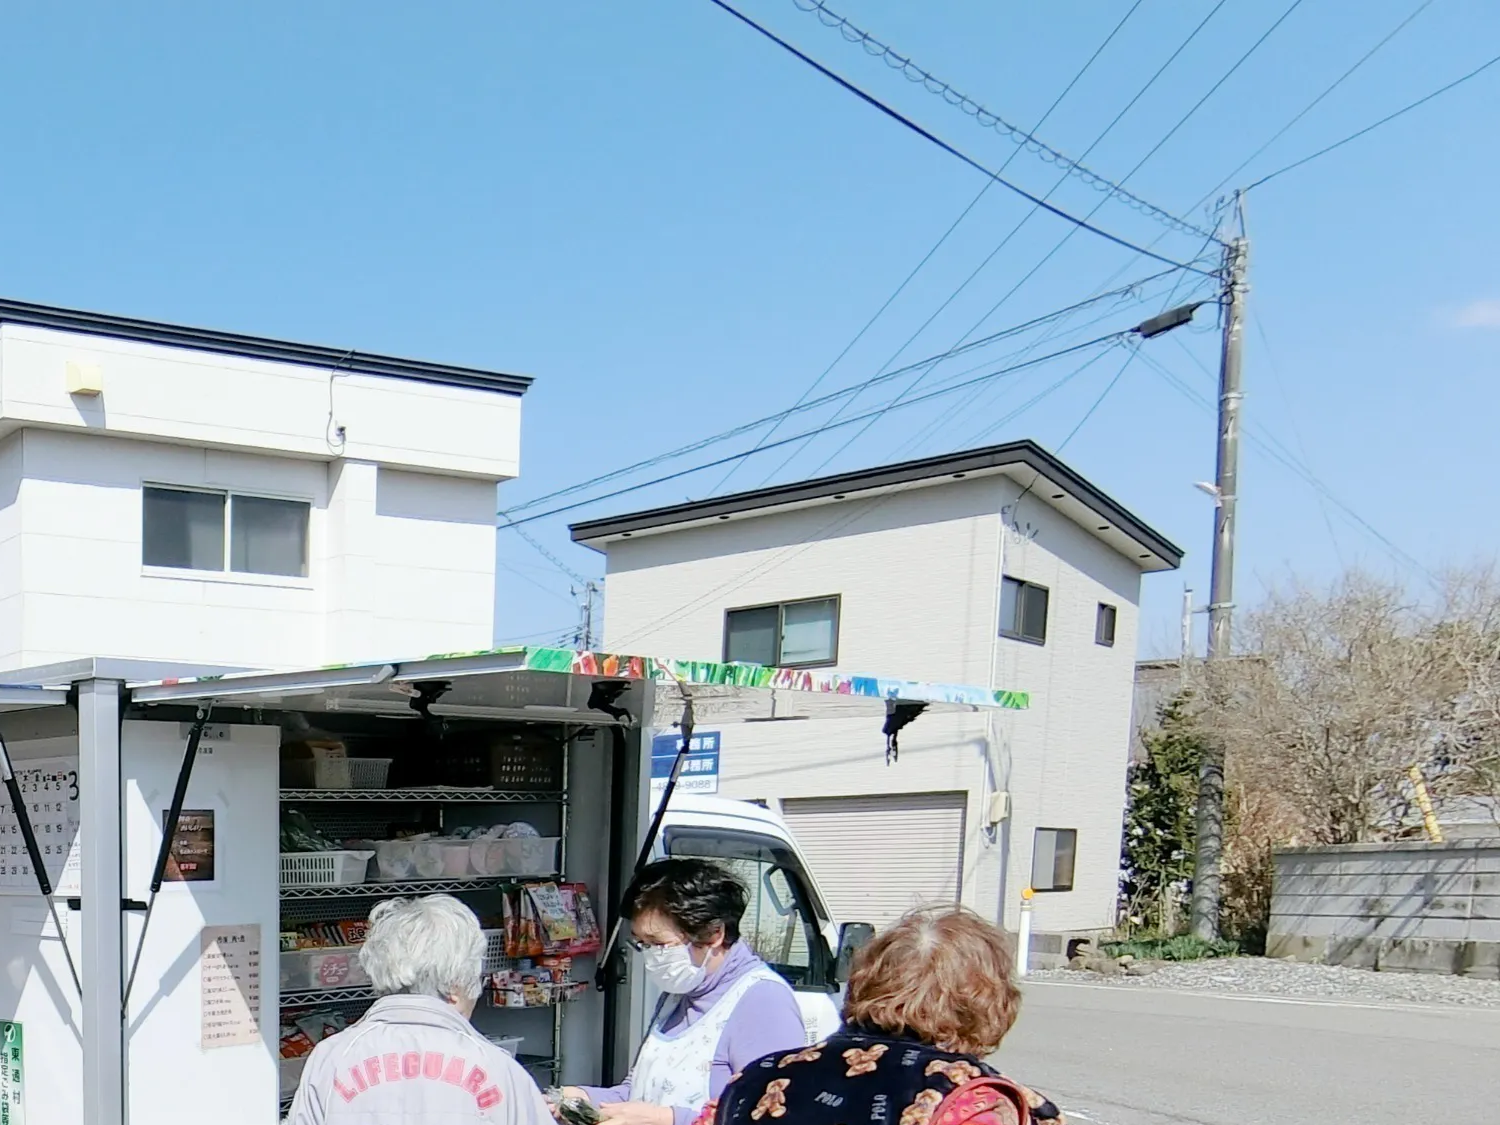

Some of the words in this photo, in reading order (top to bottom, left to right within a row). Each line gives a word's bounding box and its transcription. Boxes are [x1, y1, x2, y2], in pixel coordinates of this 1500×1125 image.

[68, 770, 80, 801] 3
[10, 1047, 22, 1105] 東通村
[334, 1051, 504, 1110] LIFEGUARD
[814, 1091, 845, 1107] POLO
[871, 1094, 888, 1120] POLO
